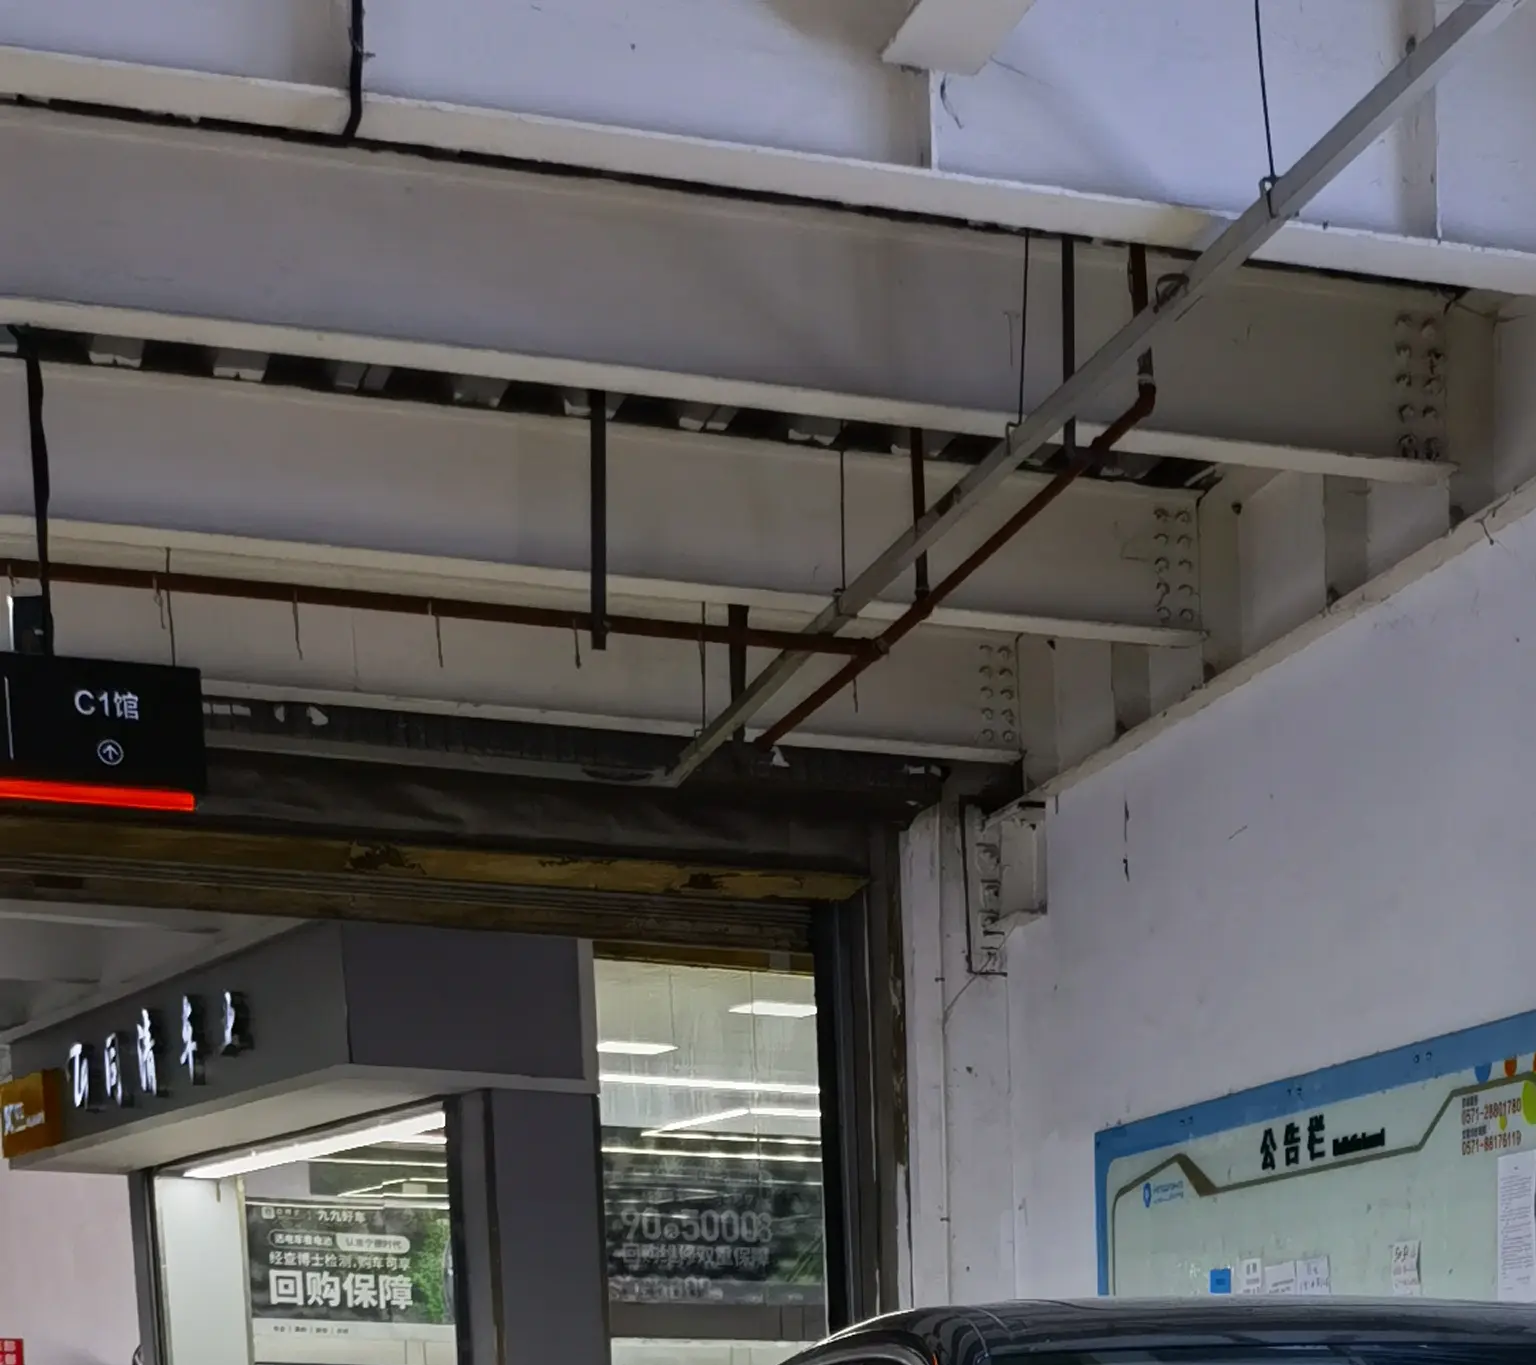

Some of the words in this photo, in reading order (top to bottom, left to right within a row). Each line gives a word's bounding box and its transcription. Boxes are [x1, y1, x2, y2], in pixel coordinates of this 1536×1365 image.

[74, 690, 139, 720] C1馆
[1260, 1113, 1325, 1170] 公告栏
[268, 1269, 414, 1310] 回购保障
